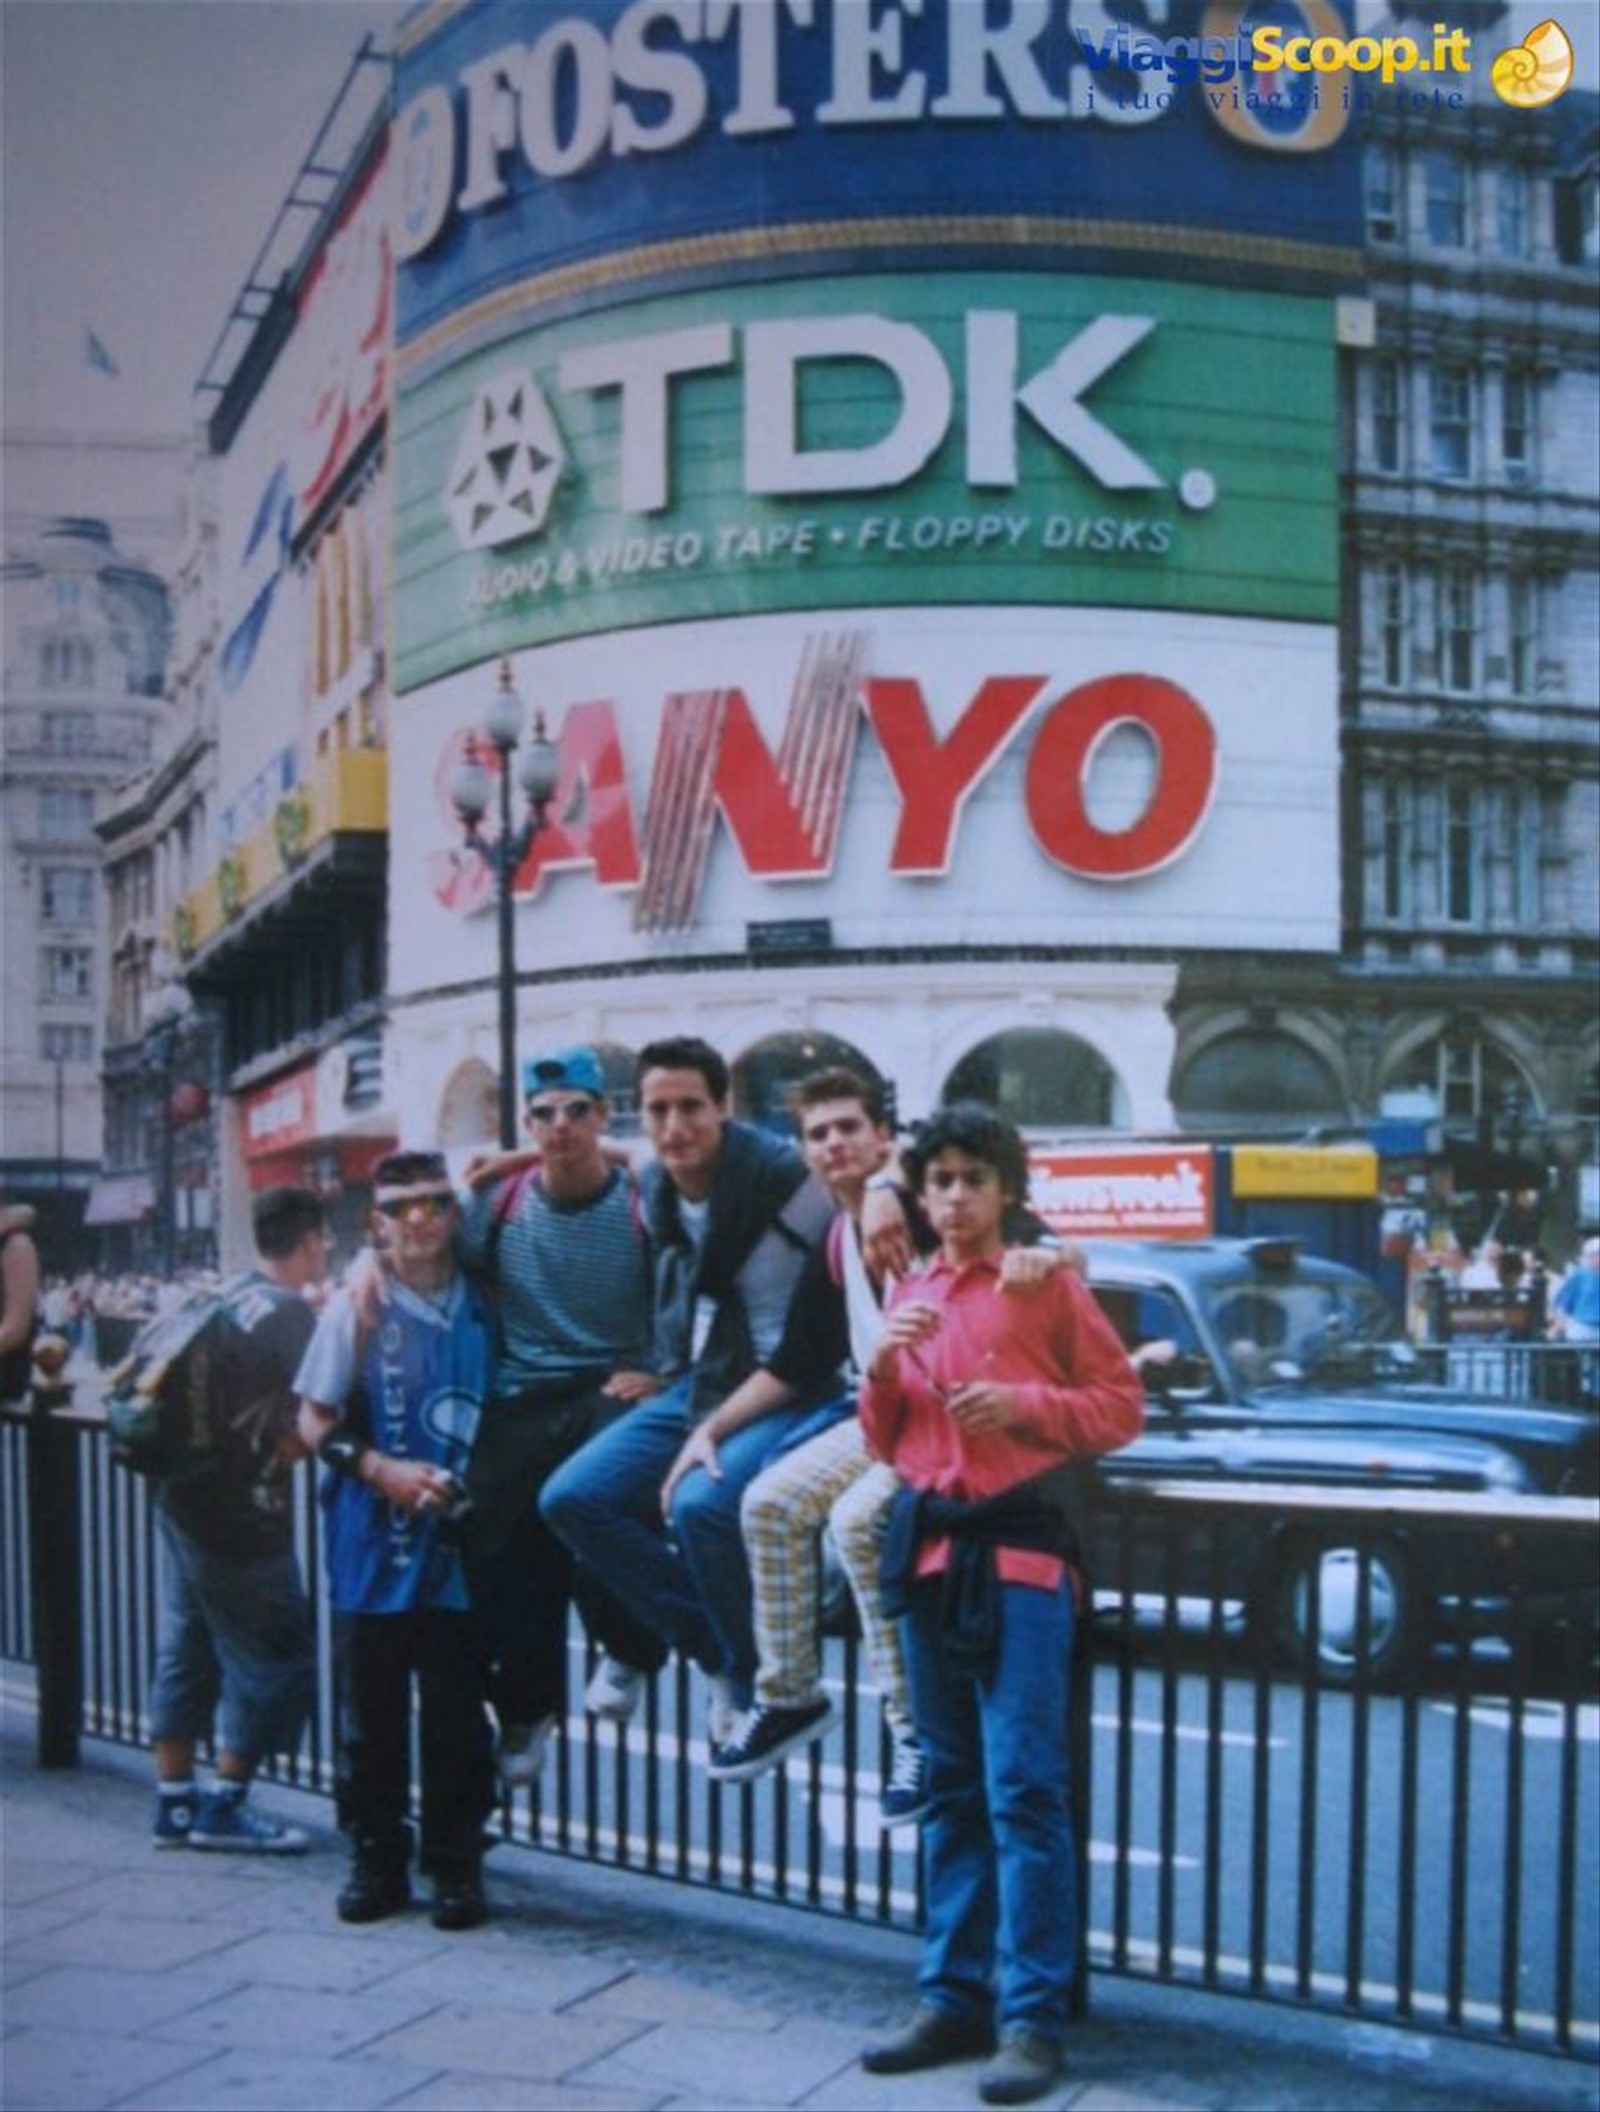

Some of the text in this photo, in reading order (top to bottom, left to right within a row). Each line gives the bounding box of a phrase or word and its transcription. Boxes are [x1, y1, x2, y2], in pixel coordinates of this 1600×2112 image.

[714, 520, 815, 562] TAPE
[857, 516, 1029, 552] FLOPPY
[1042, 516, 1174, 553] DISKS
